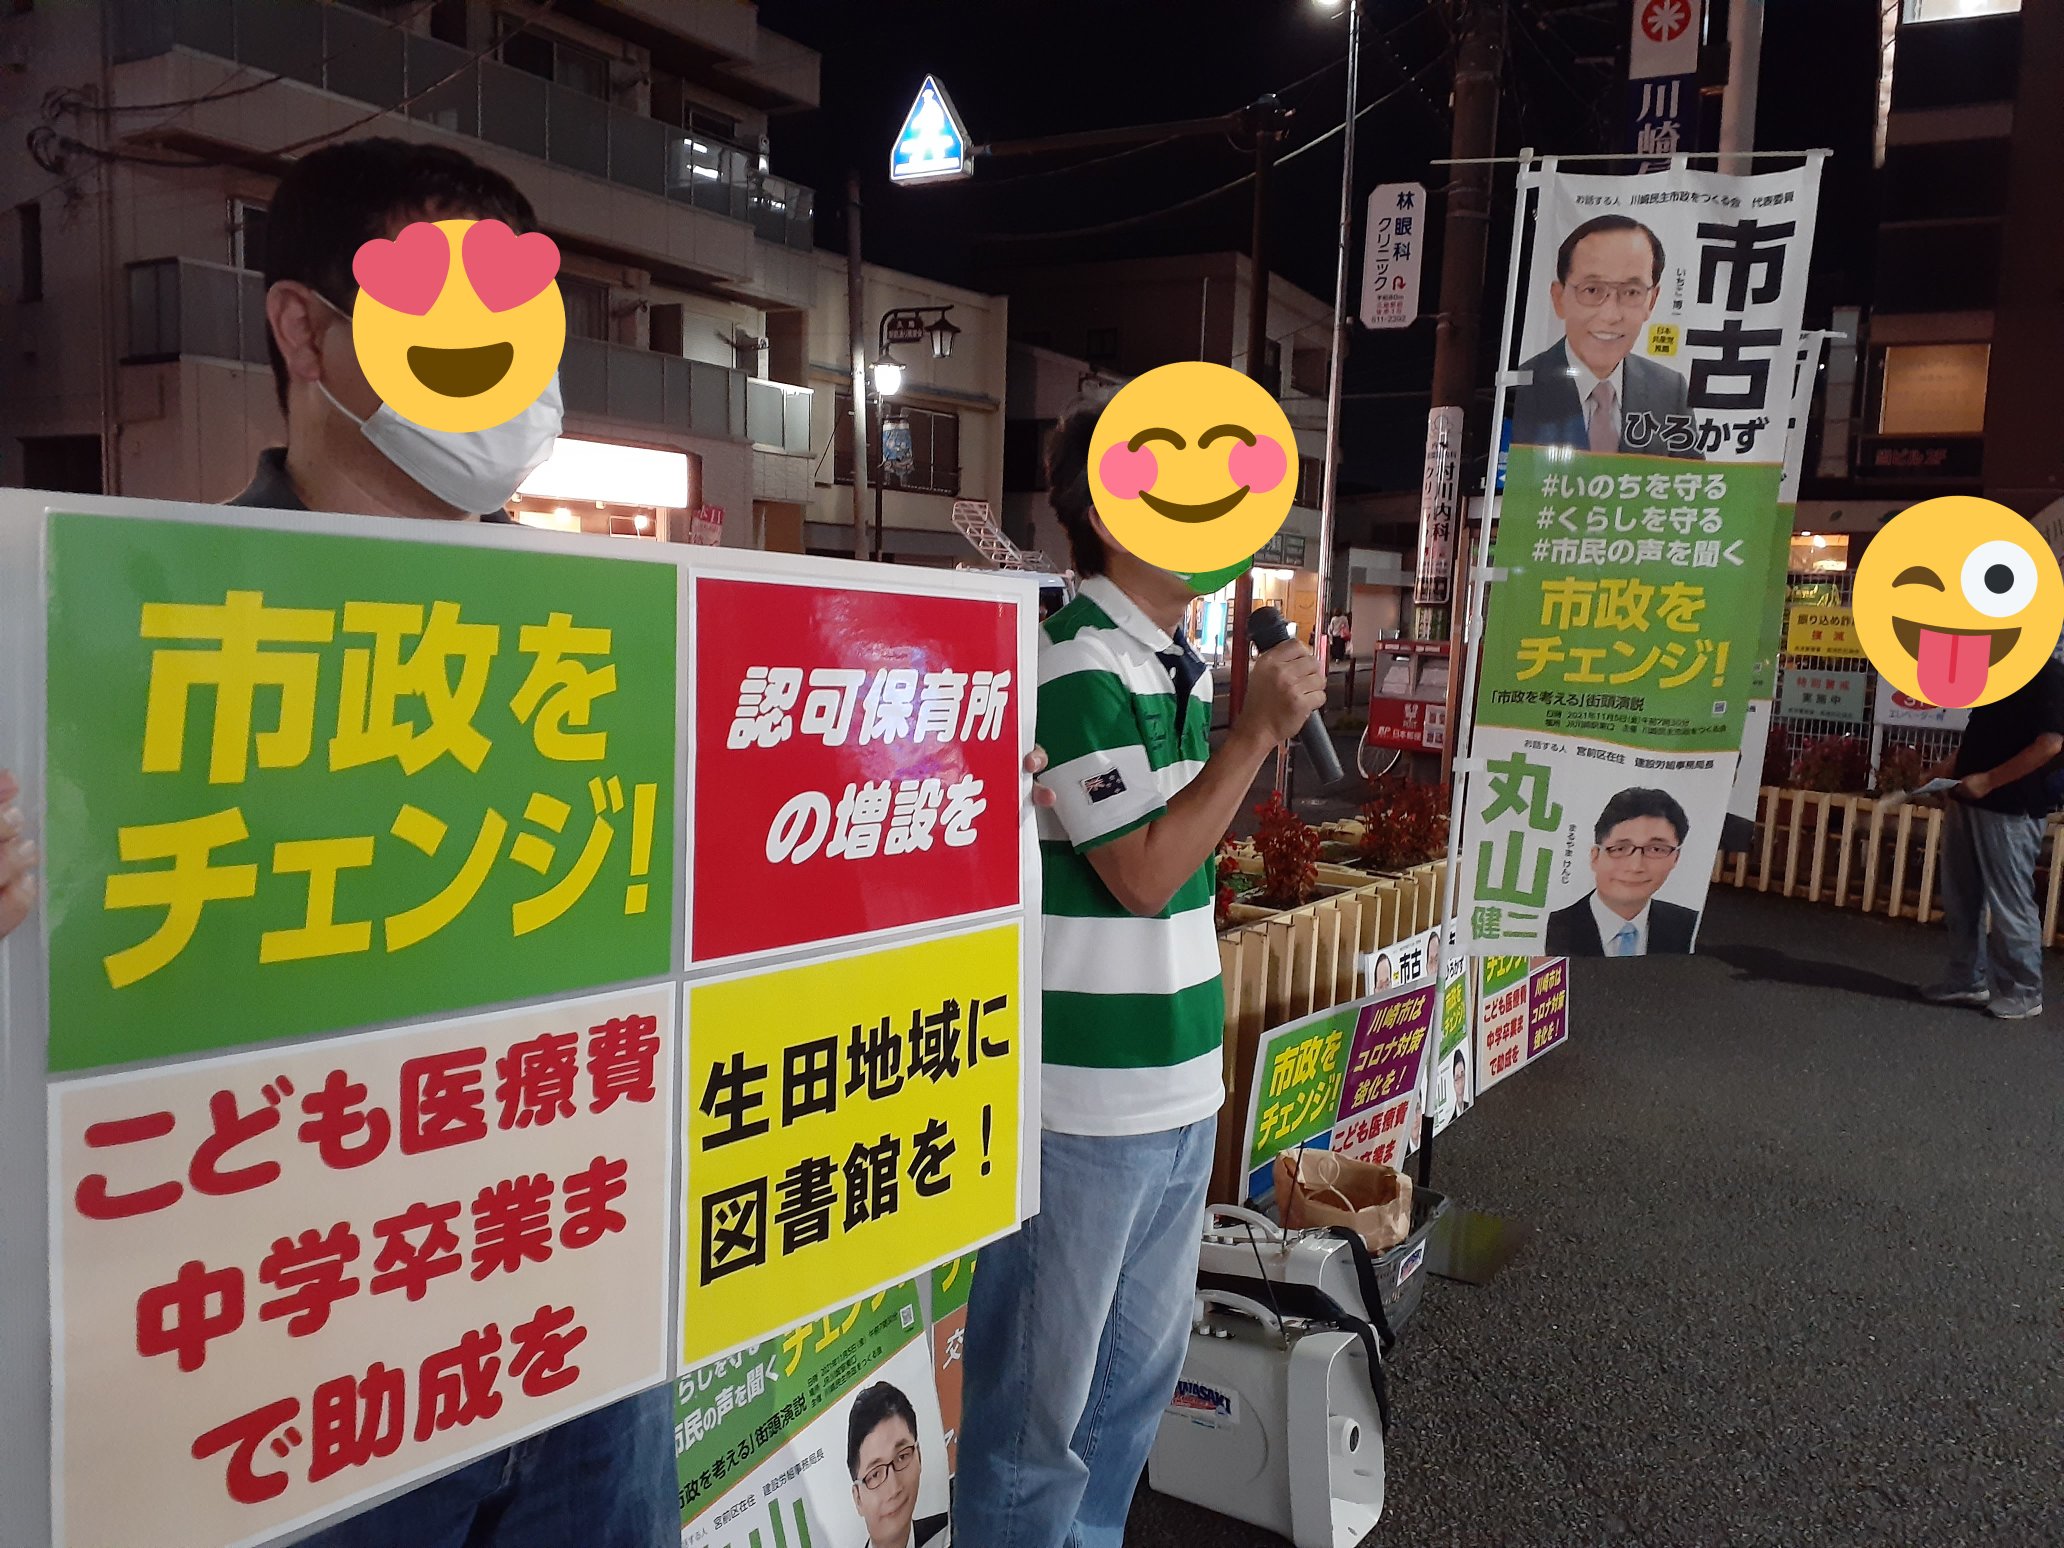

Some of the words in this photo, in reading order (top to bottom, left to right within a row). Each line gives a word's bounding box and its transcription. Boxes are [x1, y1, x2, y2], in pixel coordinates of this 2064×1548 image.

[1374, 217, 1392, 292] クリニック
[1393, 191, 1415, 261] 林眼科
[1687, 219, 1796, 411] 市古
[1624, 410, 1770, 454] ひろかず
[1536, 506, 1723, 535] #くらしを守る
[1542, 473, 1728, 500] #いのちを守る
[1532, 538, 1745, 568] #市民の声を聞く
[1540, 575, 1707, 633] 市政を
[1797, 613, 1854, 626] 振り込め詐
[140, 589, 618, 784] 市政を
[1515, 635, 1731, 689] チェンジ!
[726, 666, 1012, 752] 認可保育所
[1491, 689, 1646, 712] 「市政を考える」街頭演説
[765, 772, 988, 866] の増設を
[1473, 751, 1564, 909] 丸山
[103, 774, 658, 989] チェンジ!
[1470, 905, 1539, 942] 健二
[1399, 946, 1422, 985] 市古
[1367, 994, 1427, 1036] 川崎市は
[699, 994, 1012, 1152] 生田地域に
[1269, 1030, 1344, 1098] 市政を
[1353, 1026, 1428, 1073] コロナ対策
[75, 1014, 661, 1221] こども医療費
[1257, 1072, 1342, 1151] チェンジ!
[1351, 1065, 1408, 1110] 強化を!
[1332, 1100, 1410, 1153] こども医療費
[699, 1103, 994, 1288] 図書館を!
[135, 1156, 629, 1374] 中学卒業ま
[191, 1303, 588, 1506] で助成を
